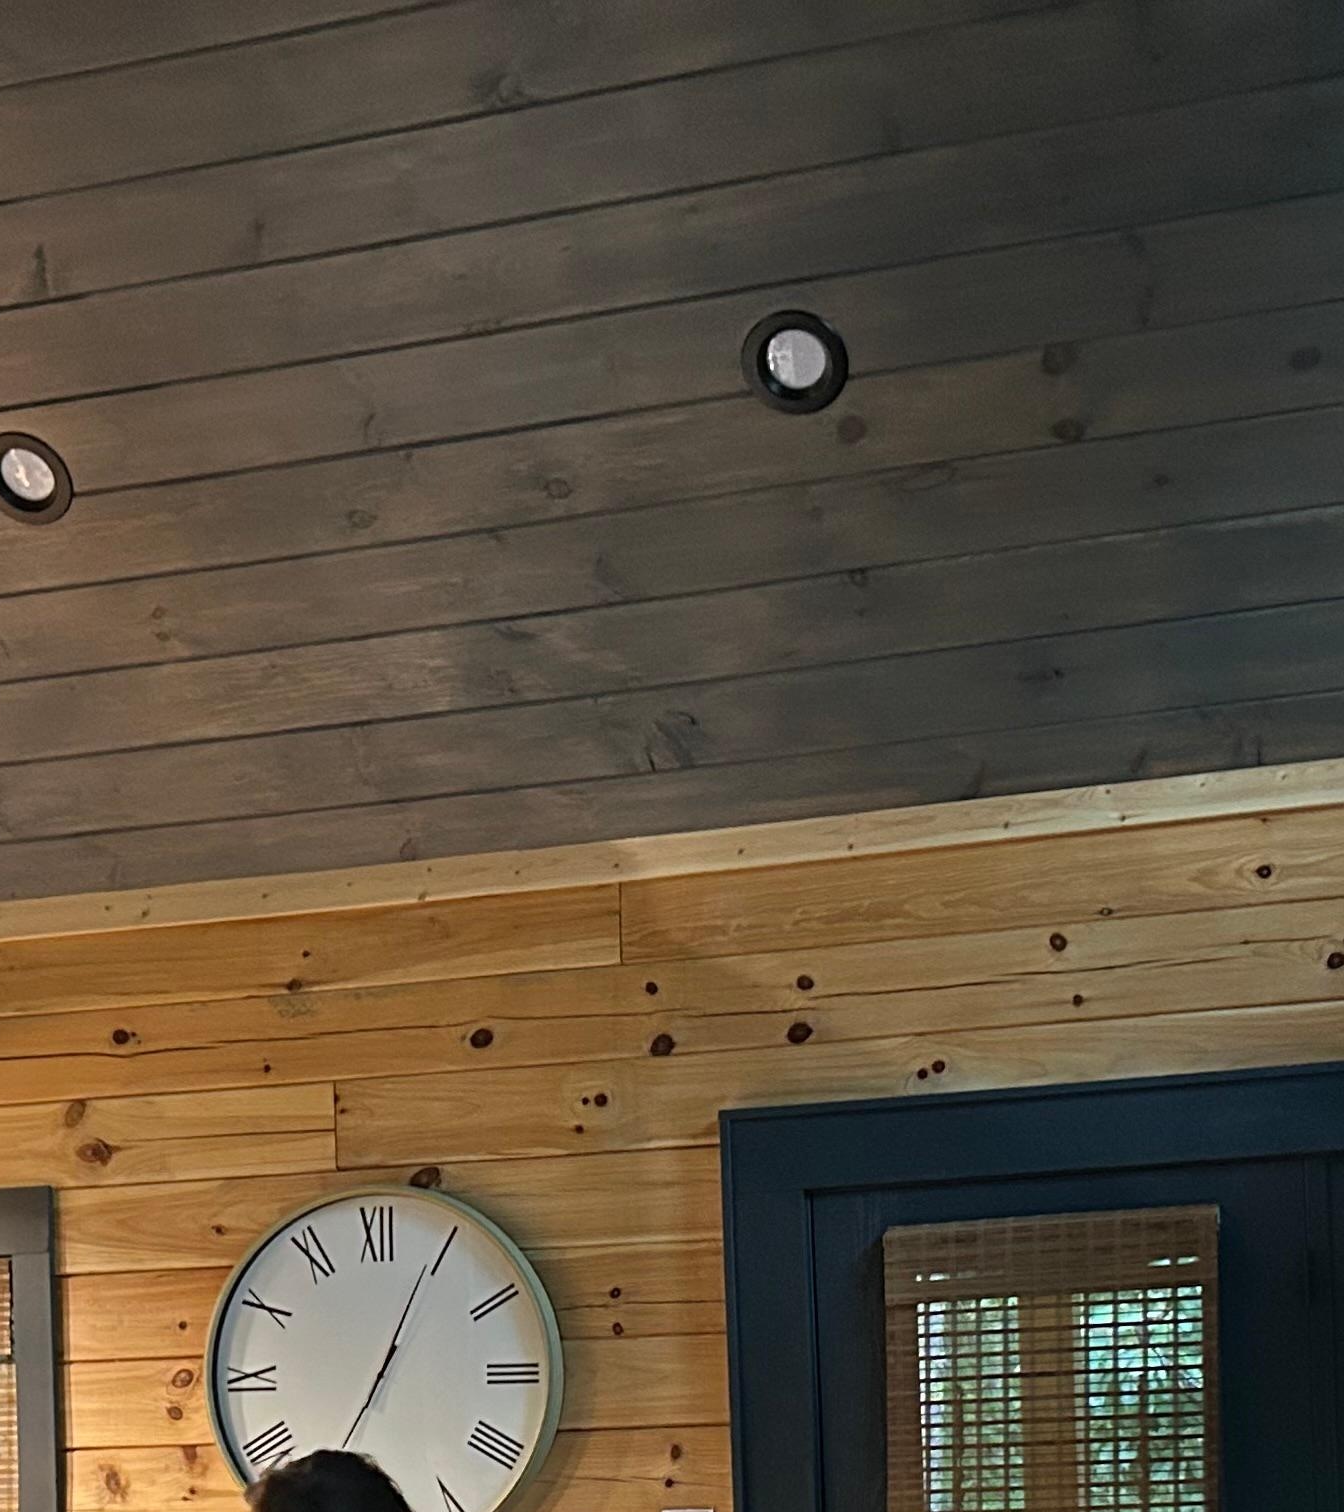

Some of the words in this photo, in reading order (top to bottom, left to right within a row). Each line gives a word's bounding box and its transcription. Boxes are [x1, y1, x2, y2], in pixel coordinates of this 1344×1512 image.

[290, 1225, 336, 1285] XI
[359, 1206, 394, 1263] XII
[430, 1226, 458, 1276] I
[242, 1288, 293, 1330] X
[470, 1283, 520, 1322] II
[227, 1365, 277, 1392] IX
[486, 1362, 540, 1385] III
